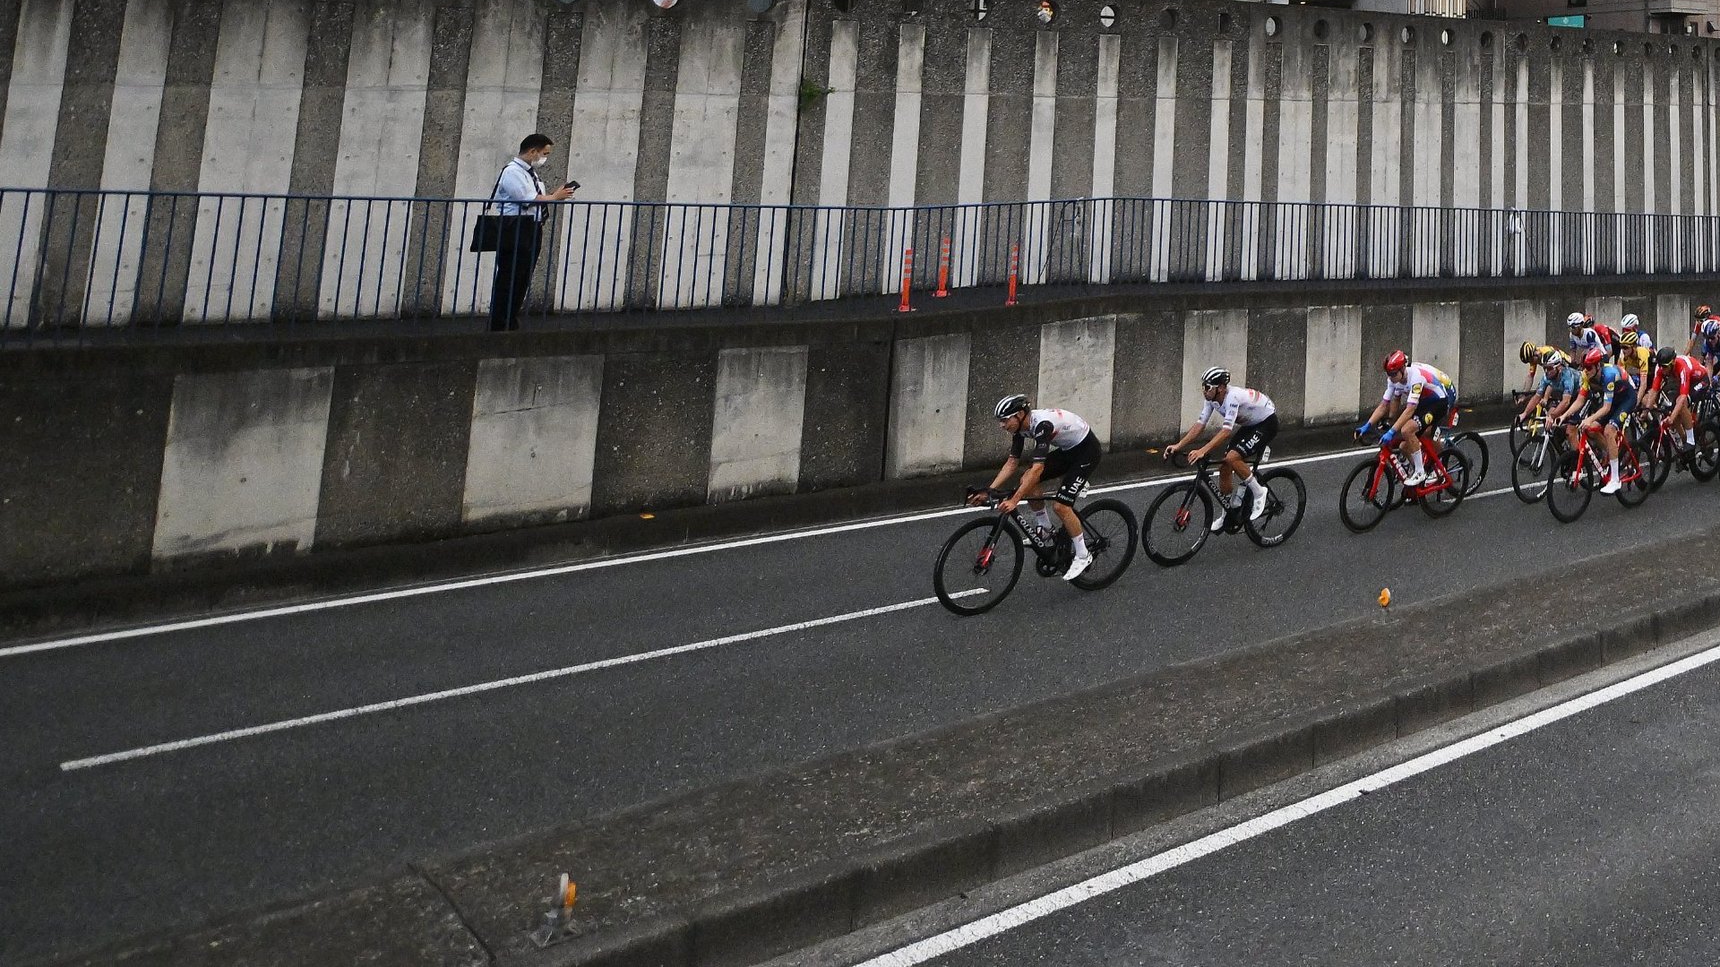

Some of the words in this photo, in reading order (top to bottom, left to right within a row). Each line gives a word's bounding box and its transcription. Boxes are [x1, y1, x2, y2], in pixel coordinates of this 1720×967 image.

[1245, 434, 1260, 449] UAE
[1068, 476, 1085, 495] UAE
[1016, 514, 1045, 548] COLNAGO
